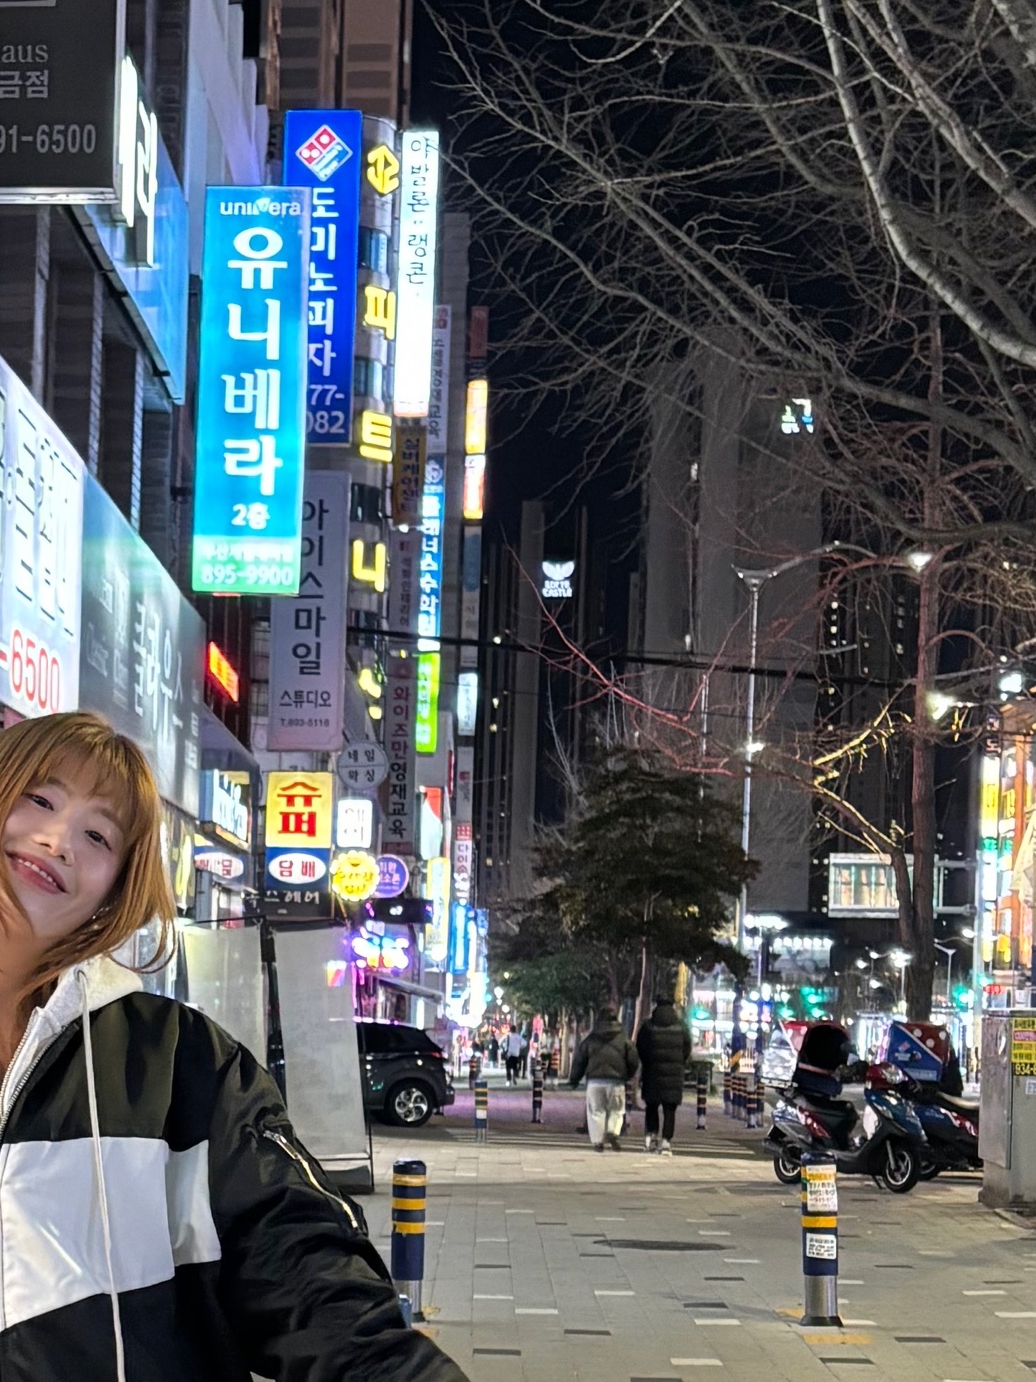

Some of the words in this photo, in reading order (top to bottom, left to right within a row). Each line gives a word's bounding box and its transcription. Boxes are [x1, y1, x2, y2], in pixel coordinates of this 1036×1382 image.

[308, 187, 339, 376] 도미노피자
[221, 227, 288, 496] 유니베라
[202, 564, 294, 586] 895-9900
[292, 499, 330, 676] 아이스마일
[279, 690, 331, 709] 스튜디오
[277, 781, 322, 837] 슈퍼
[388, 686, 410, 839] 와이즈만영재교육
[278, 859, 315, 877] 담배
